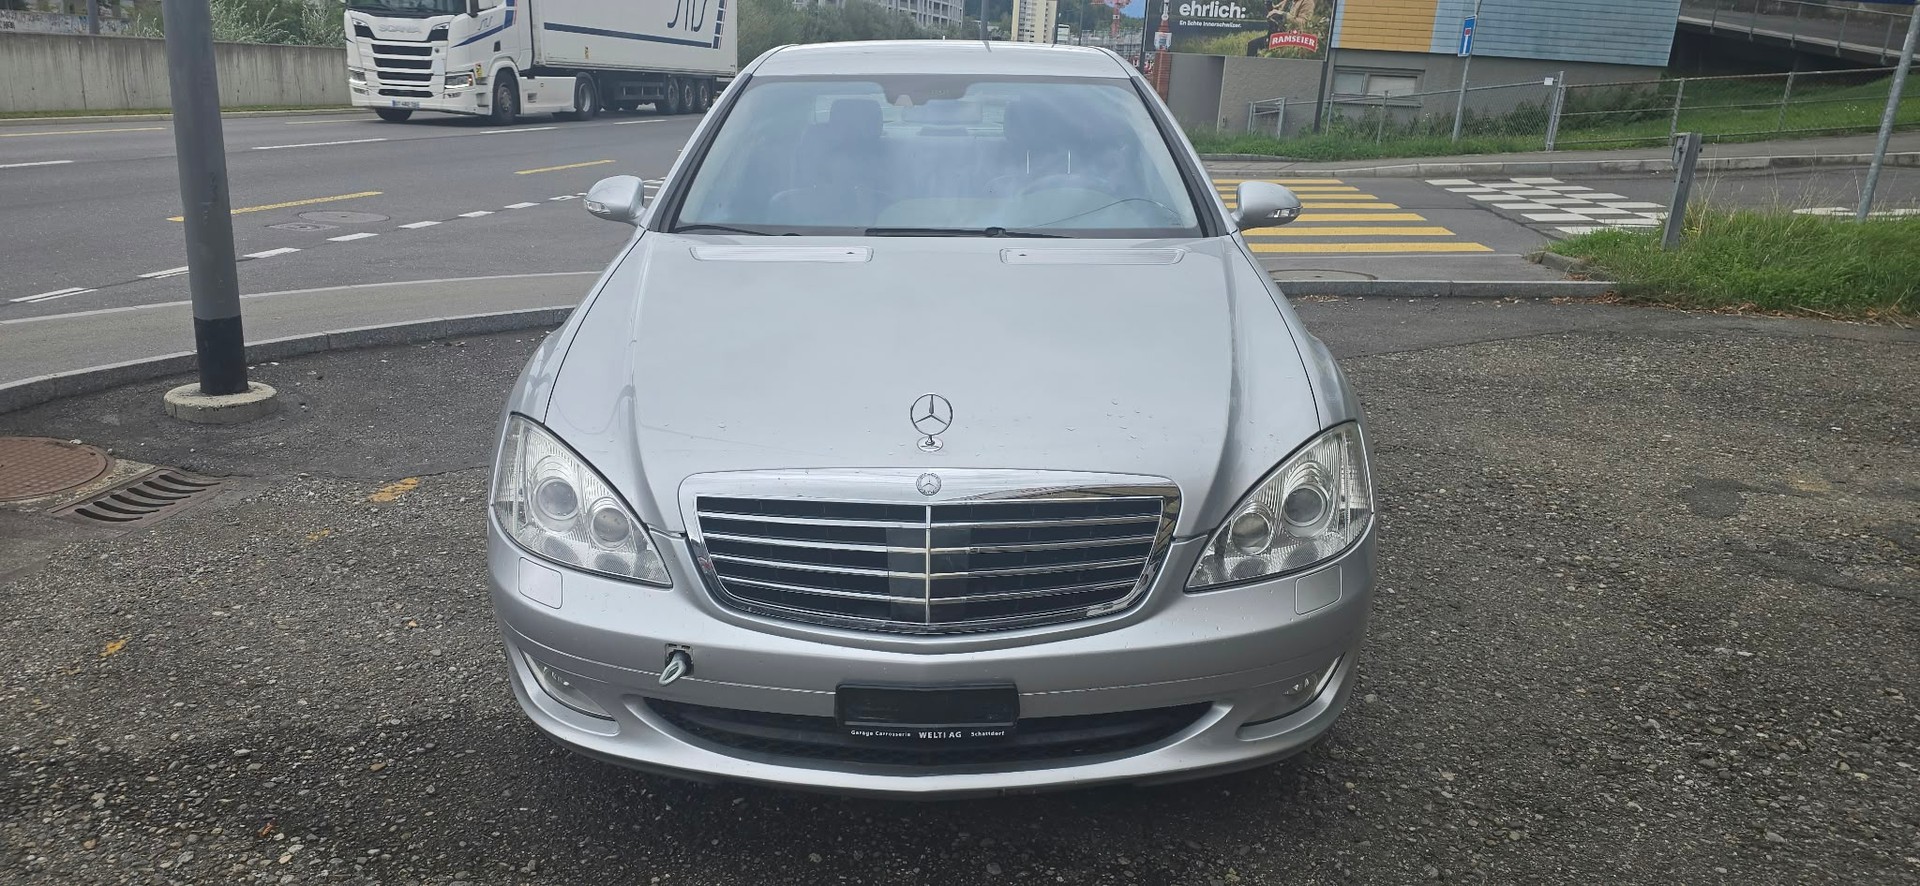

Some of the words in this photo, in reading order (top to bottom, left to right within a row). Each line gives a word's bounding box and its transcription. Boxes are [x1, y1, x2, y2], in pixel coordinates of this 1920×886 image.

[1179, 0, 1246, 18] ehrlich:
[1272, 35, 1315, 46] RAMSEIER
[850, 729, 873, 737] Garage
[919, 731, 946, 739] WELTI
